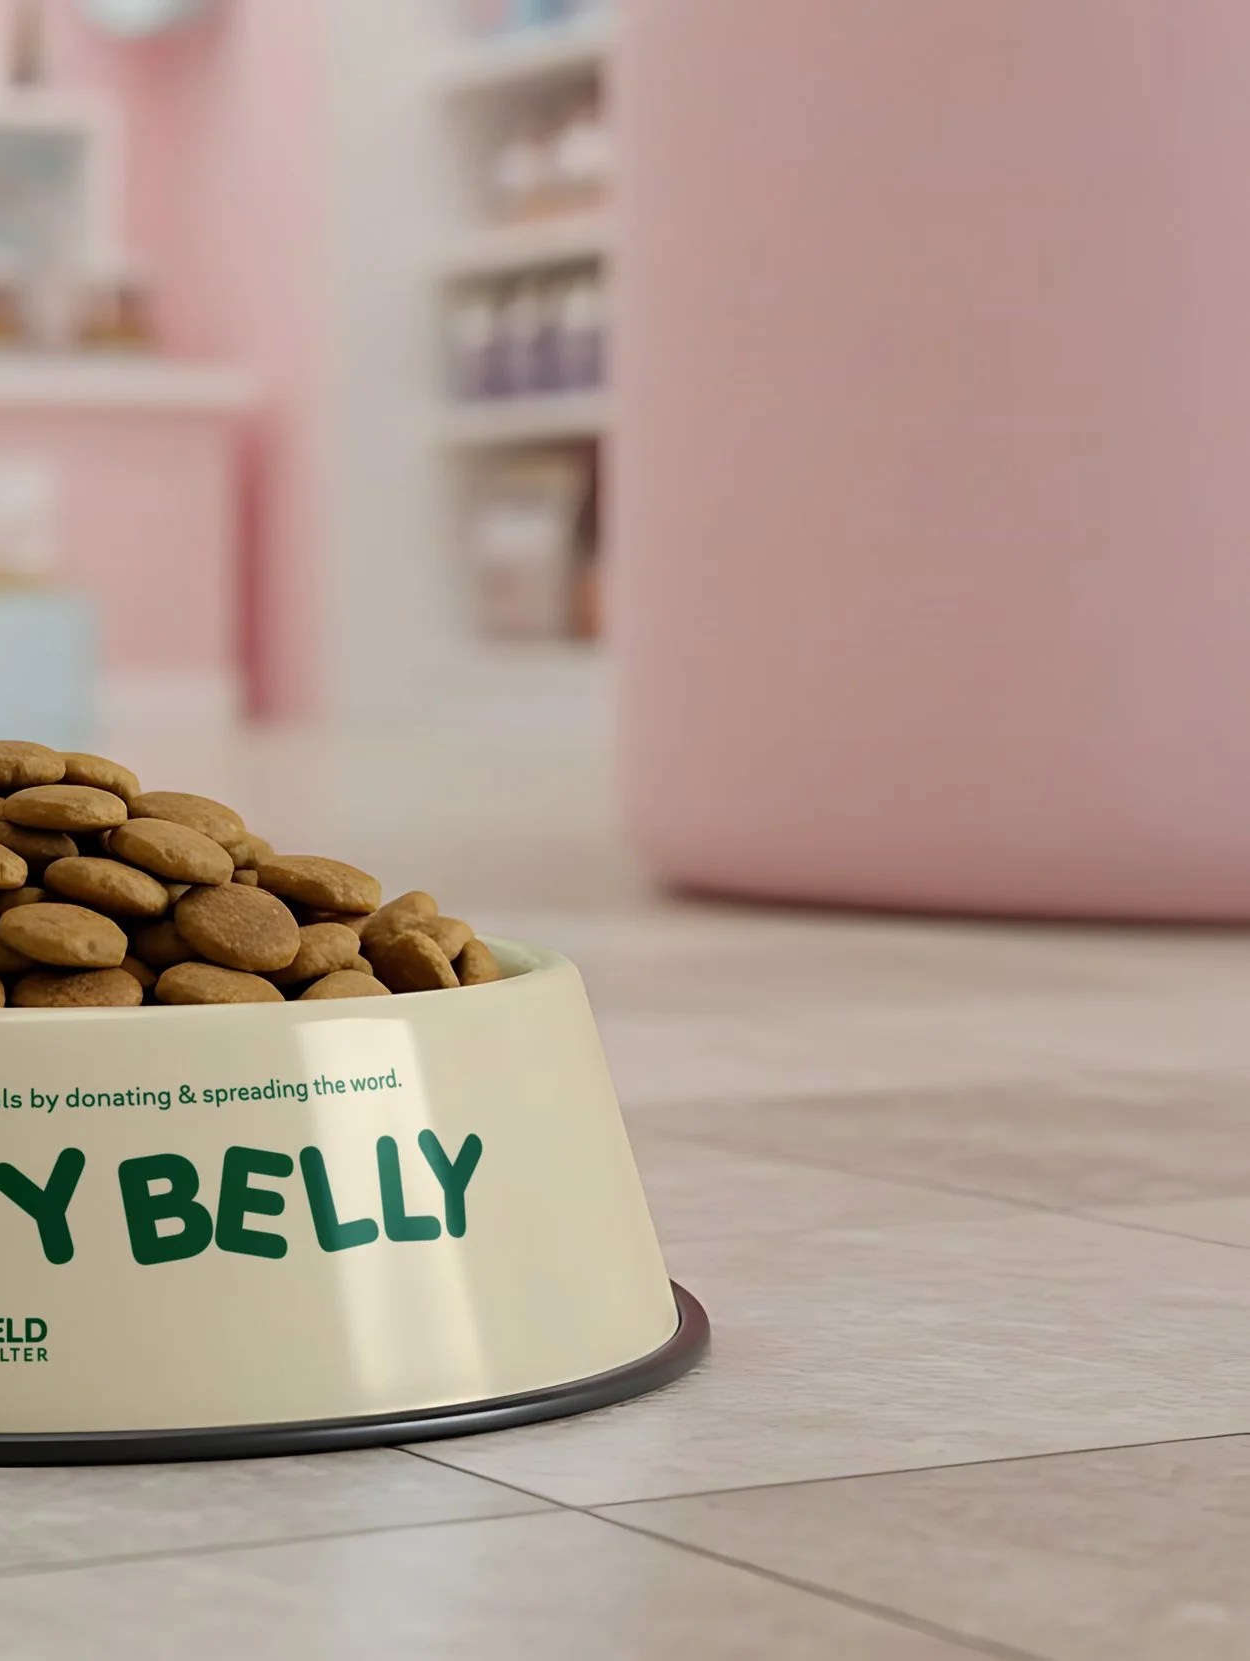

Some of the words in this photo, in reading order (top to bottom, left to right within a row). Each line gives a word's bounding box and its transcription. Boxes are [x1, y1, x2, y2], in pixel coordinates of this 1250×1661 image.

[30, 1087, 58, 1113] by
[65, 1086, 171, 1110] donating
[178, 1085, 198, 1104] &
[203, 1079, 308, 1108] spreading
[313, 1075, 345, 1095] the
[350, 1068, 403, 1091] word.
[118, 1129, 482, 1265] BELLY
